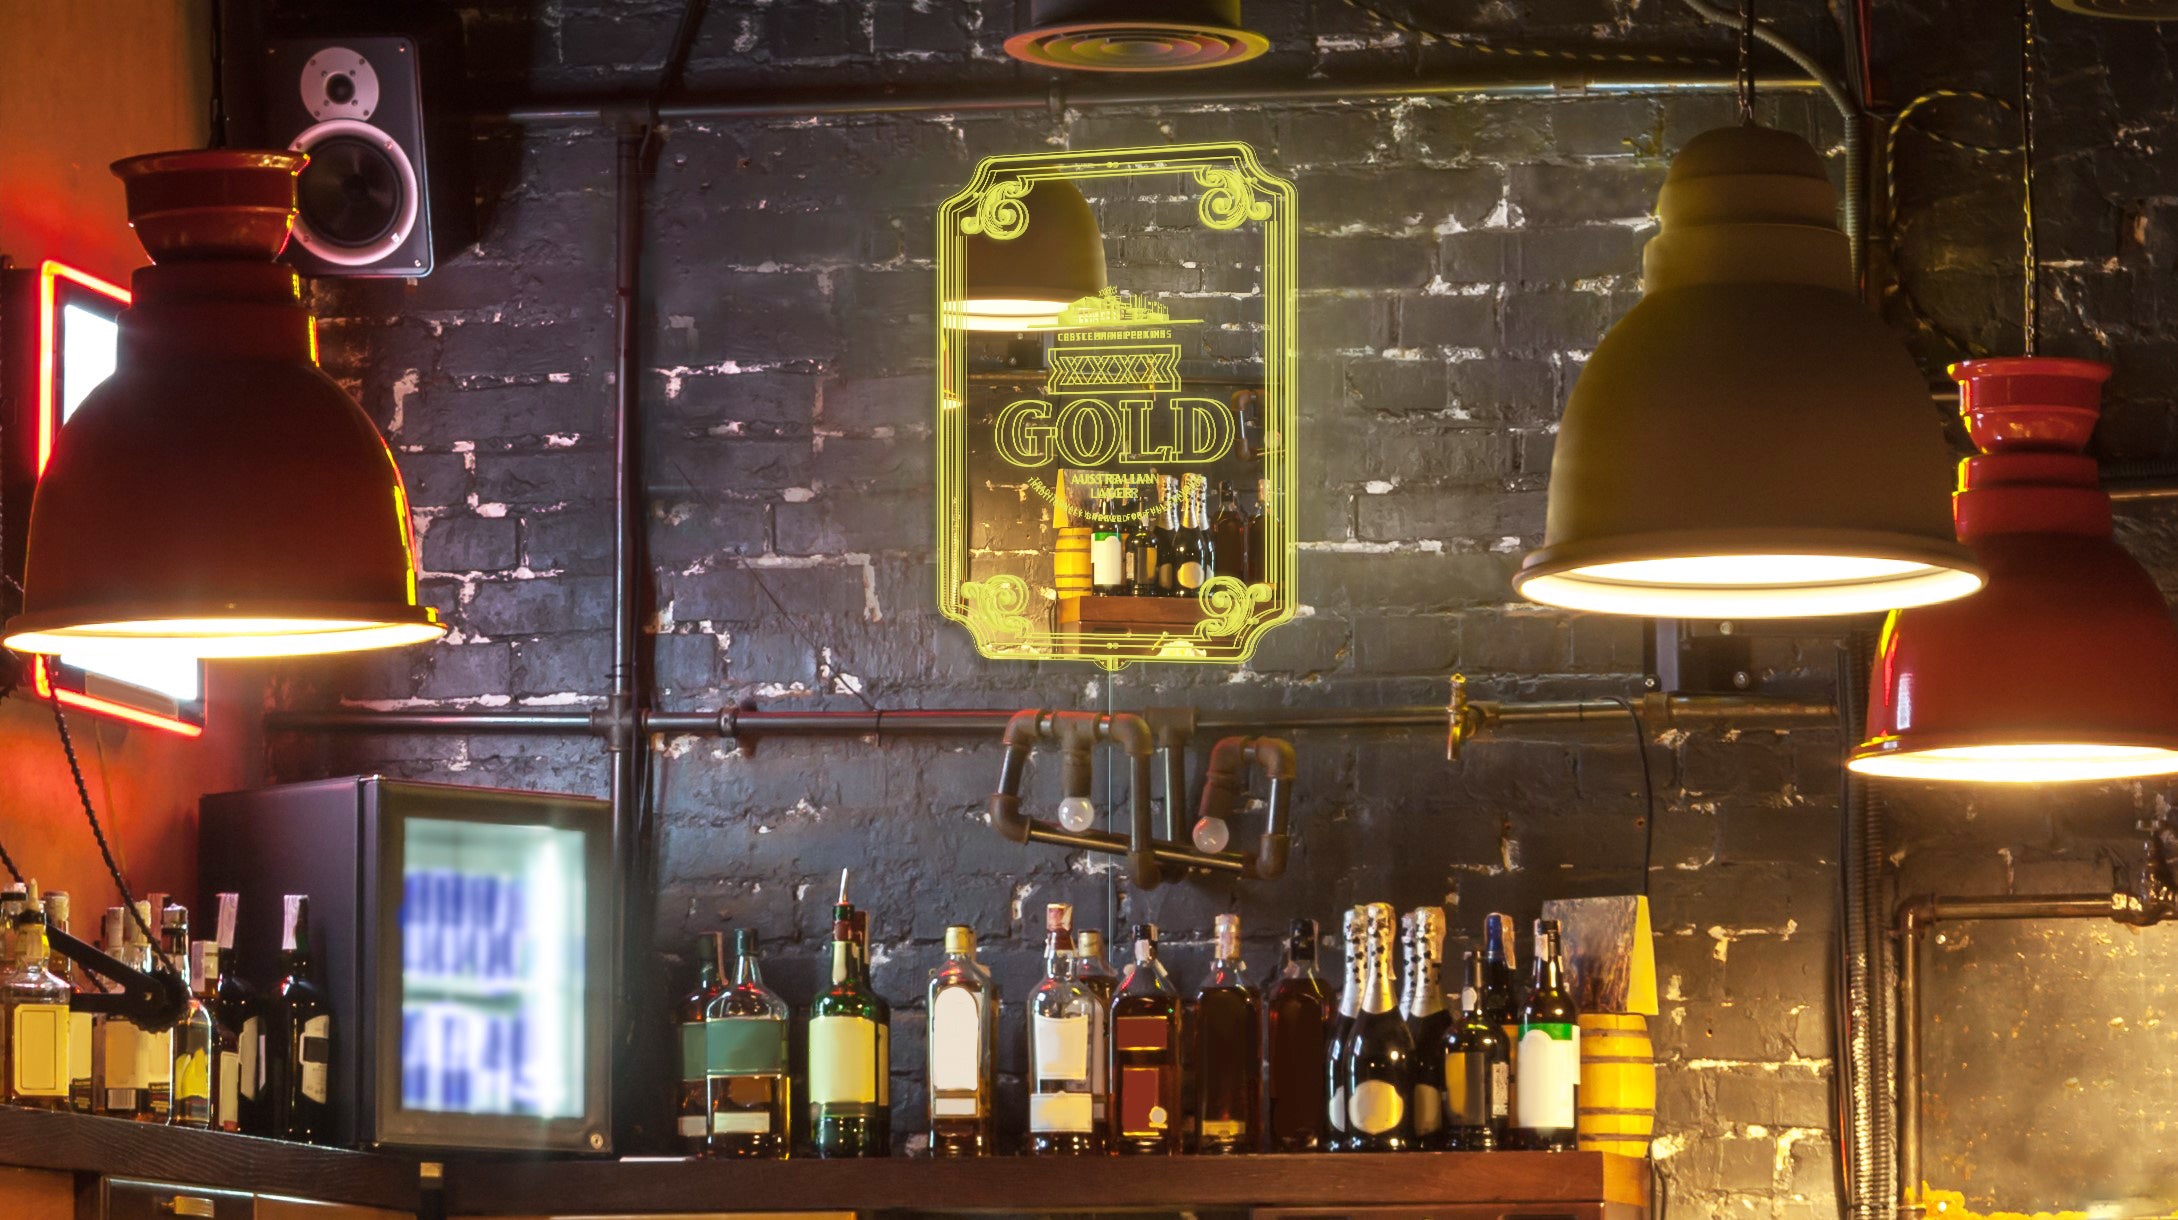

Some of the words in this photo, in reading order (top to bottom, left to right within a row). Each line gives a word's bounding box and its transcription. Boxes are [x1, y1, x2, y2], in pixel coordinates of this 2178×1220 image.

[1059, 353, 1171, 386] XXXX
[994, 397, 1236, 468] GOLD
[1071, 473, 1159, 485] AUSTRALIAN
[1090, 487, 1139, 499] LAGER
